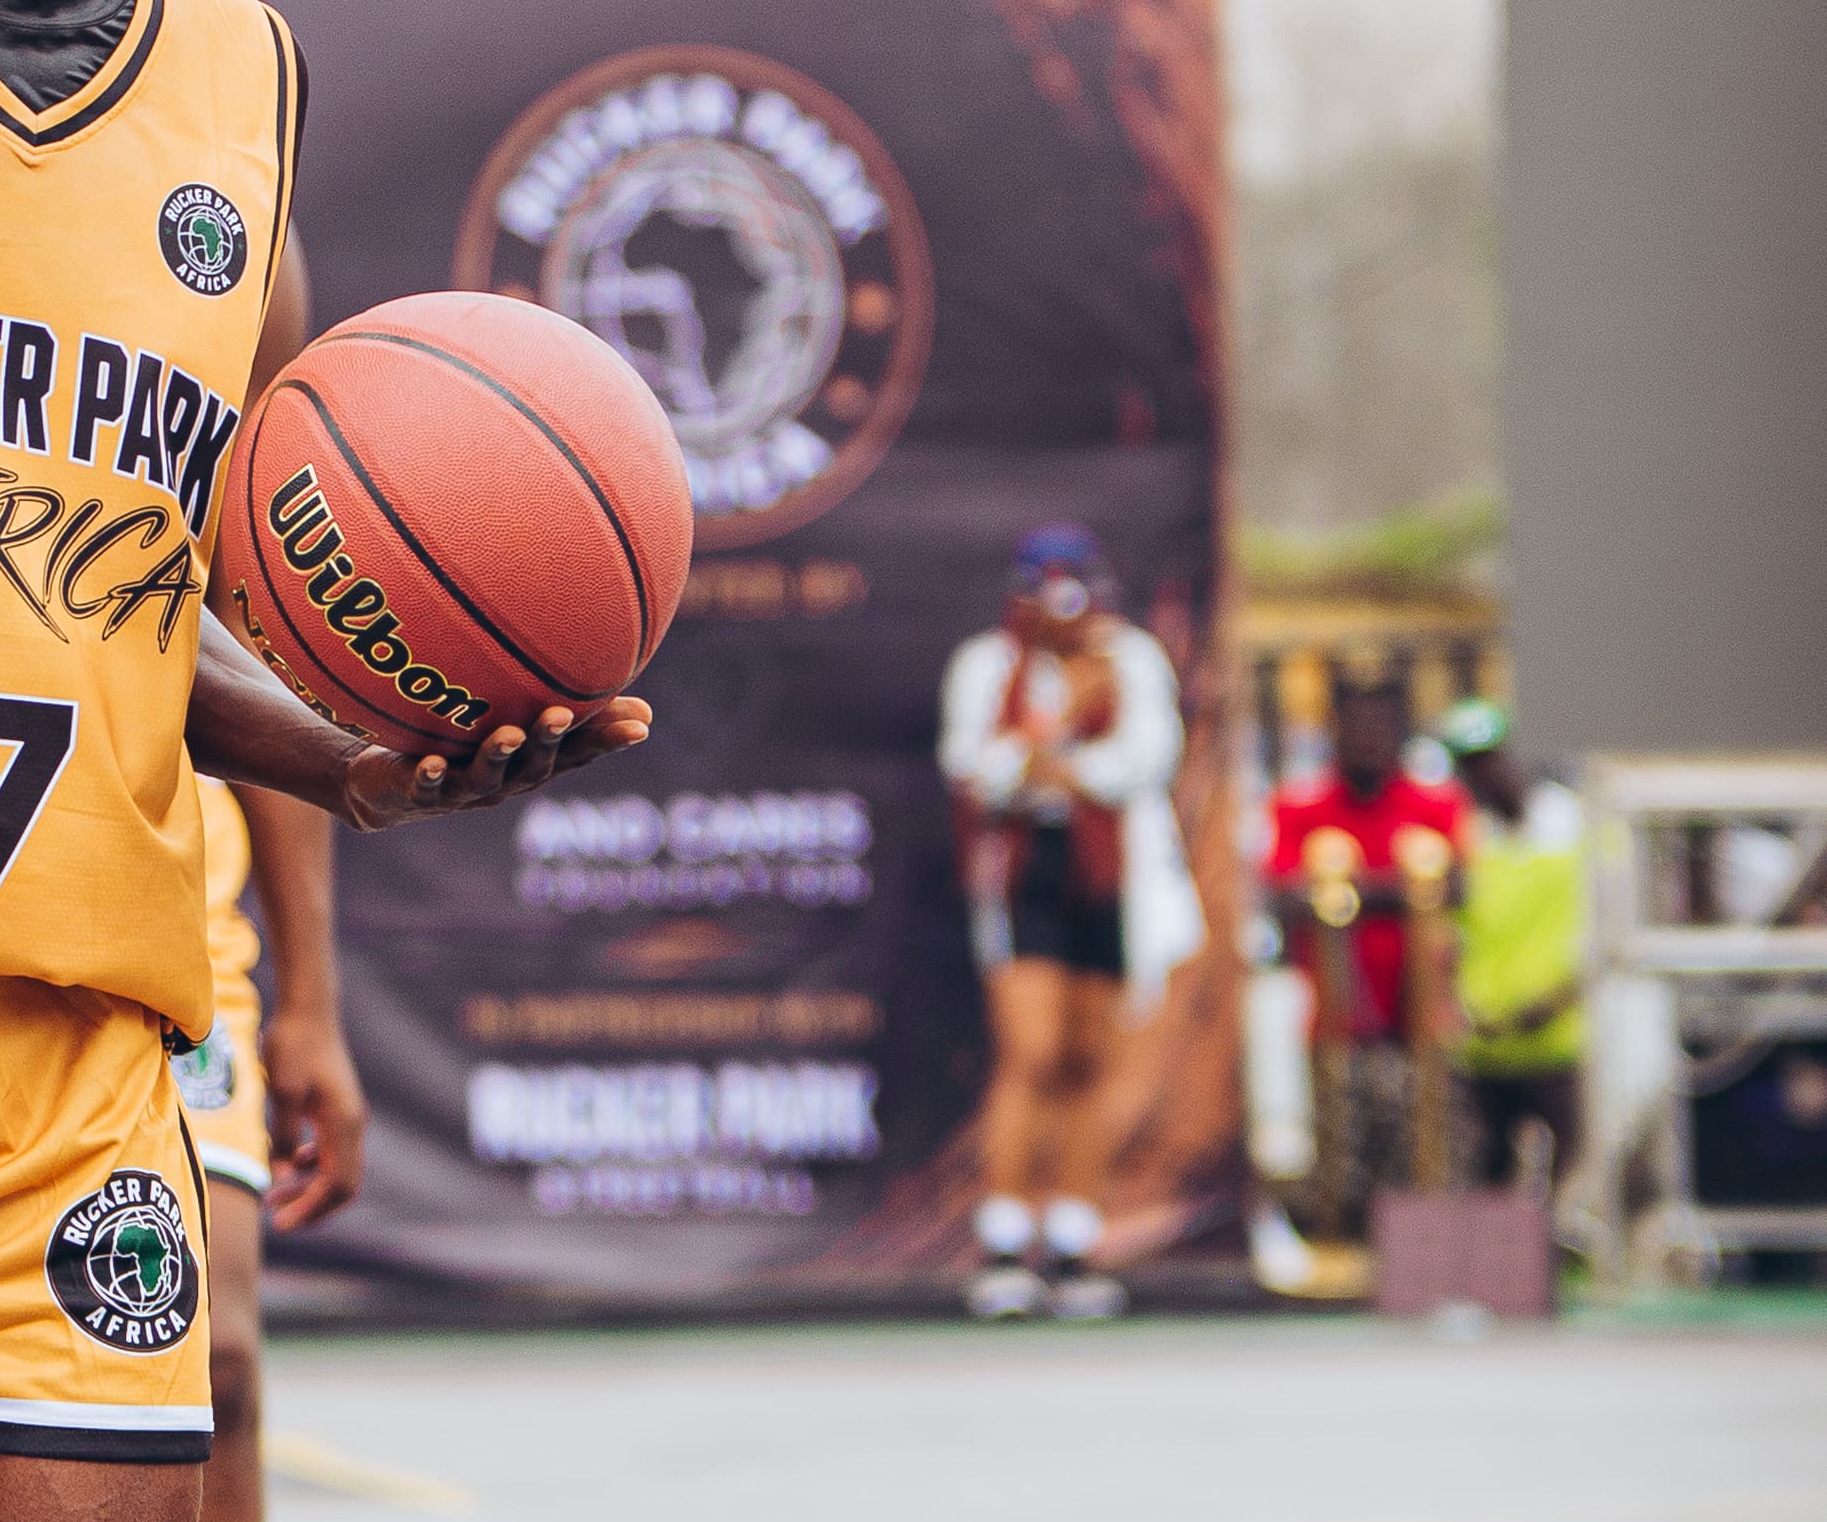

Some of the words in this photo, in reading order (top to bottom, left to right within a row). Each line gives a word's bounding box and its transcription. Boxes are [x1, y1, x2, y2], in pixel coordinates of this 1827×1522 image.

[164, 188, 213, 222] RUCKER
[214, 196, 244, 236] PARK
[176, 263, 232, 292] AFRICA
[68, 332, 241, 543] PARK
[268, 463, 490, 731] Wilson
[63, 1177, 141, 1247] RUCKER
[150, 1179, 186, 1243] PARK
[86, 1305, 187, 1345] AFRICA
